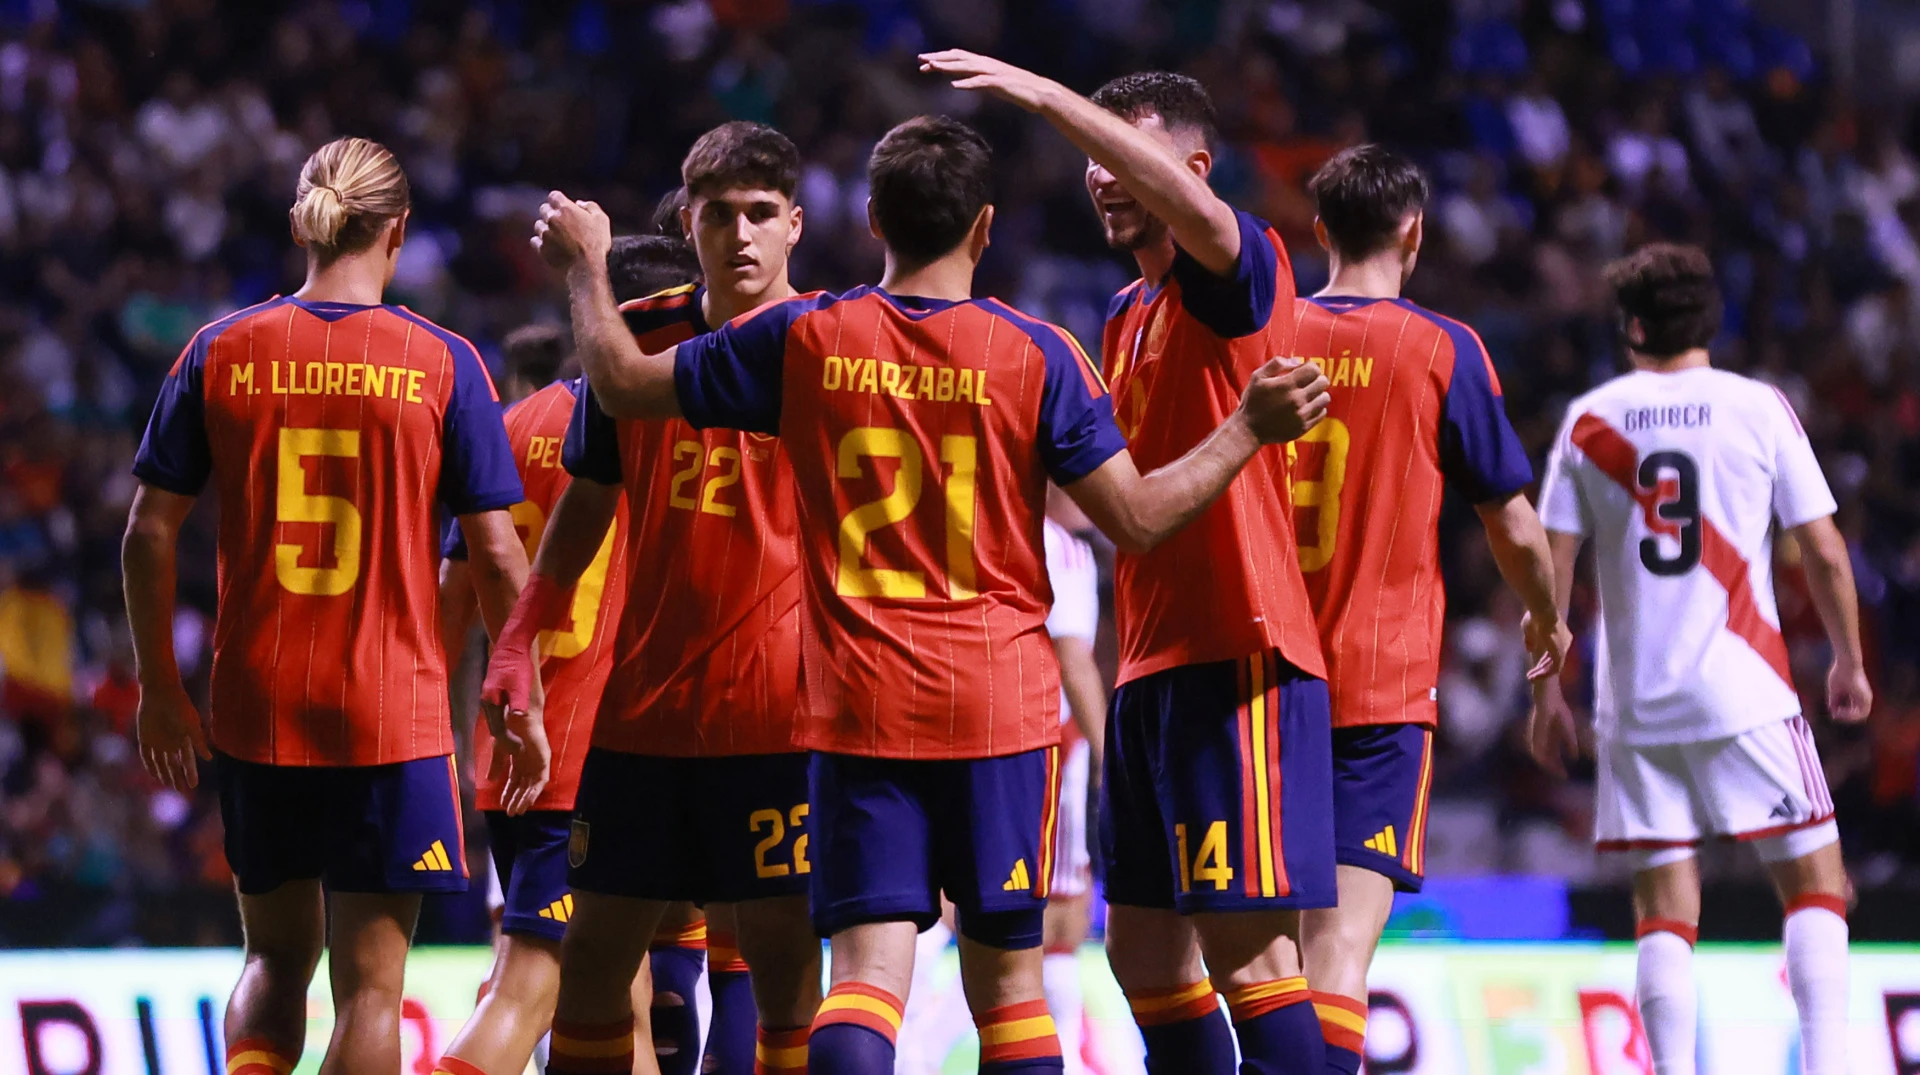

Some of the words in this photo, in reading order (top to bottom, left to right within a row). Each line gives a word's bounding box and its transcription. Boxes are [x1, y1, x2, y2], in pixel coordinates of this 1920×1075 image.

[230, 362, 261, 396] M.
[271, 360, 427, 404] LLORENTE
[823, 355, 992, 406] OYARZABAL
[275, 427, 363, 597] 5
[669, 439, 741, 518] 22
[837, 426, 979, 601] 21
[1638, 450, 1702, 577] 3
[1175, 820, 1234, 892] 14
